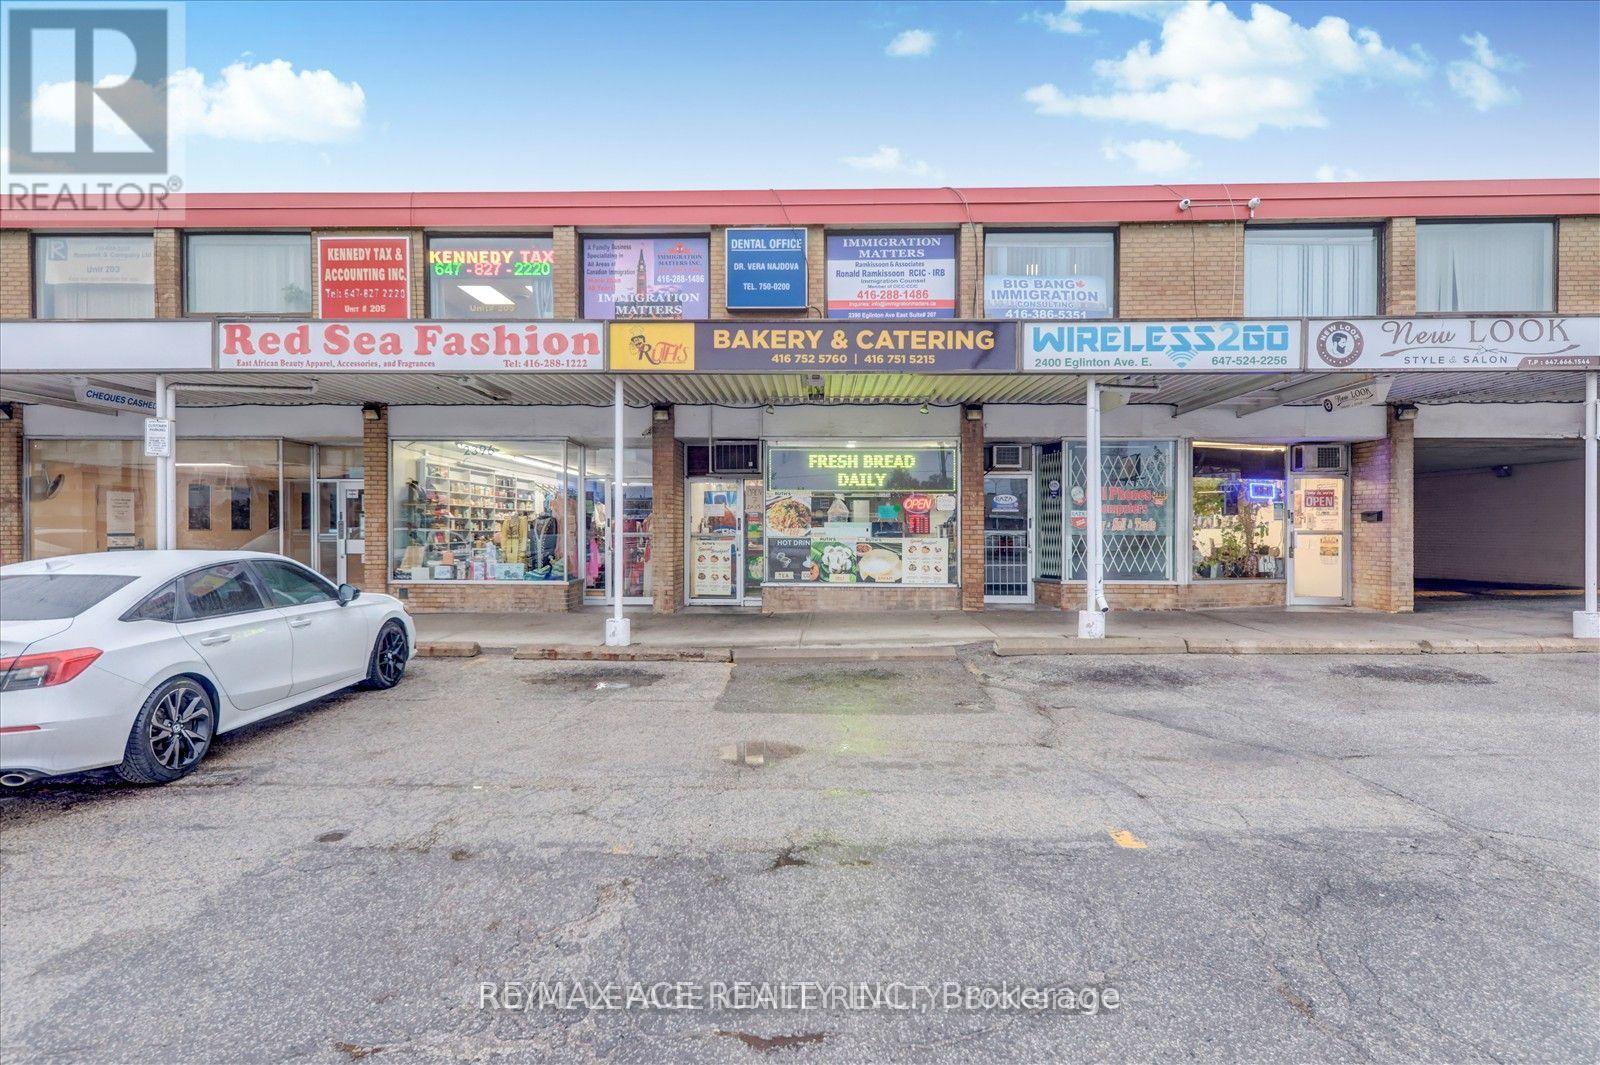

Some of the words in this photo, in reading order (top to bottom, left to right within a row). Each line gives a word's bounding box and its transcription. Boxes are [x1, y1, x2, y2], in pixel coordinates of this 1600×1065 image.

[731, 239, 767, 249] DENTAL
[769, 238, 802, 249] OFFICE
[842, 237, 943, 248] IMMIGRATION
[327, 248, 371, 261] KENNEDY
[373, 248, 392, 261] TAX
[395, 248, 403, 261] &
[429, 250, 514, 264] KENNEDY
[519, 250, 555, 264] TAX
[858, 248, 925, 258] MATTERS
[733, 262, 746, 270] DR.
[747, 262, 765, 270] VERA
[767, 262, 799, 270] NAJDOVA
[324, 268, 385, 281] ACCOUNTING
[656, 274, 705, 283] 416-288-1486
[835, 269, 860, 278] Ronald
[861, 268, 905, 278] Ramkissoon
[908, 268, 927, 277] RCIC
[932, 268, 946, 277] IRB
[743, 282, 757, 290] TEL.
[759, 282, 791, 290] 750-0200
[1003, 279, 1029, 289] BIG
[1034, 279, 1075, 289] BANG
[598, 293, 700, 303] IMMIGRATION
[857, 290, 929, 300] 416-288-1486
[991, 289, 1098, 301] IMMIGRATION
[369, 305, 386, 313] 205
[1017, 300, 1074, 308] CONSULTING
[615, 305, 683, 315] MATTERS
[1005, 309, 1087, 319] 416-386-5351
[1033, 322, 1289, 353] WIRELESS2GO
[1320, 325, 1336, 341] NEW
[1340, 324, 1361, 340] LOOK
[1381, 320, 1456, 345] New
[1469, 319, 1570, 343] LOOK
[223, 324, 312, 355] Red
[323, 324, 403, 355] Sea
[414, 325, 601, 355] Fashion
[713, 329, 824, 349] BAKERY
[830, 329, 849, 349] &
[855, 329, 995, 350] CATERING
[236, 359, 252, 367] East
[252, 359, 279, 367] African
[280, 360, 304, 368] Beauty
[305, 360, 336, 368] Apparel,
[336, 360, 381, 368] Accessories,
[397, 359, 436, 368] Fragrances
[503, 359, 522, 367] Tel:
[523, 359, 588, 368] 416-288-1222
[771, 354, 791, 363] 416
[795, 354, 815, 363] 752
[818, 354, 848, 363] 5760
[864, 354, 885, 363] 416
[887, 354, 906, 363] 751
[909, 354, 936, 363] 5215
[1034, 358, 1061, 367] 2400
[1064, 357, 1110, 369] Eglinton
[1113, 357, 1138, 367] Ave.
[1141, 356, 1152, 367] E.
[1211, 355, 1288, 366] 647-524-2256
[1404, 356, 1445, 365] STYLE
[1463, 355, 1508, 364] SALON
[1350, 387, 1372, 399] LOOK
[86, 390, 126, 404] CHEQUES
[127, 397, 157, 410] CASHED
[808, 454, 858, 468] FRESH
[863, 454, 916, 468] BREAD
[837, 472, 888, 487] DAILY
[905, 498, 932, 510] OPEN
[1306, 496, 1333, 507] OPEN
[1099, 503, 1150, 517] omputers
